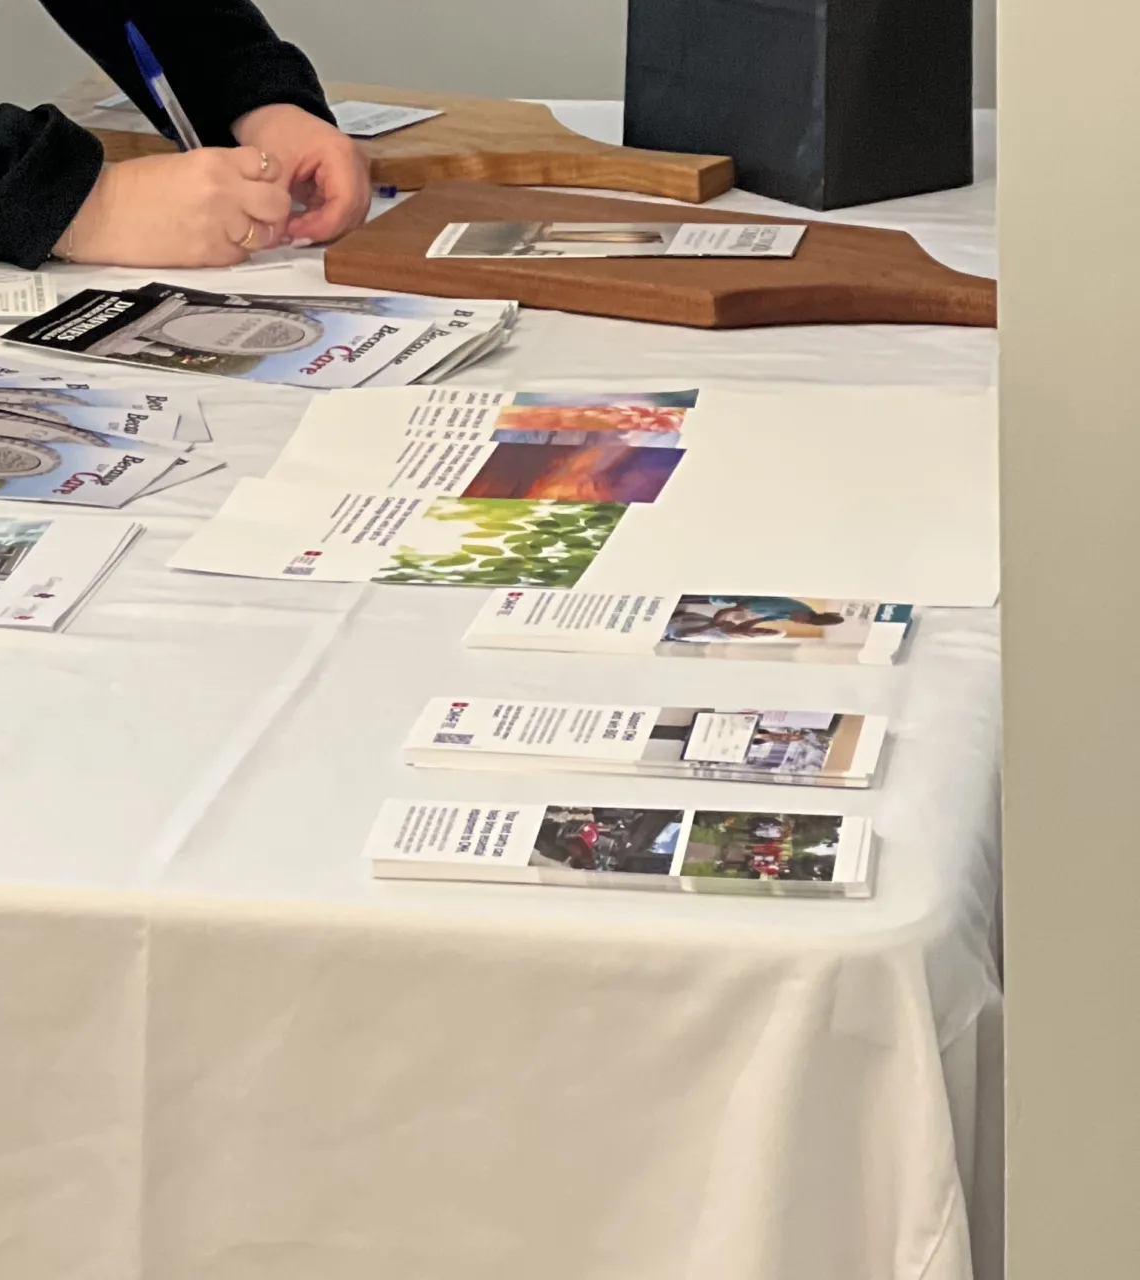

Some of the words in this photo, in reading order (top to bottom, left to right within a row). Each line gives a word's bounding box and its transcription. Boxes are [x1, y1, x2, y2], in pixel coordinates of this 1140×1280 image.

[57, 300, 135, 341] DUMFRIES
[346, 324, 400, 364] Because
[298, 345, 357, 375] Care
[51, 471, 105, 495] Care
[485, 809, 501, 821] help
[504, 810, 520, 822] Your
[479, 820, 497, 835] bring
[500, 822, 514, 834] next
[473, 834, 490, 857] essential
[493, 833, 510, 848] party
[492, 848, 504, 857] can
